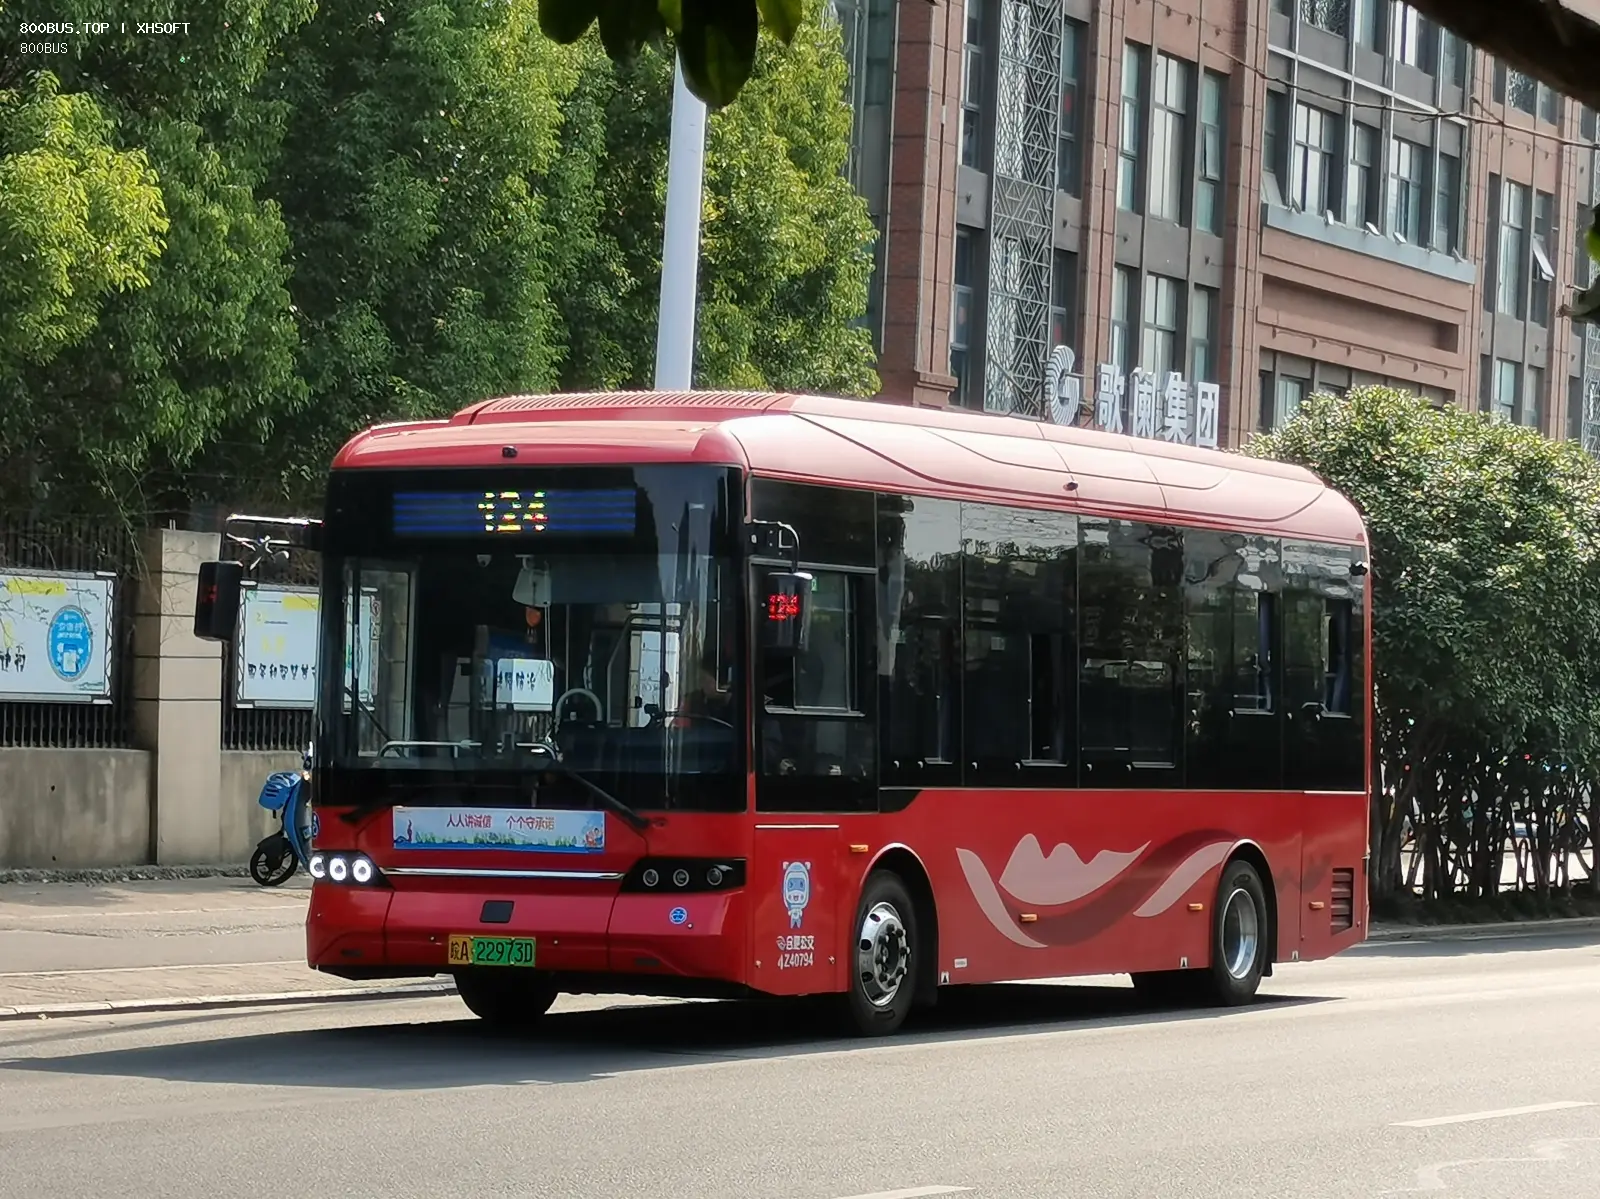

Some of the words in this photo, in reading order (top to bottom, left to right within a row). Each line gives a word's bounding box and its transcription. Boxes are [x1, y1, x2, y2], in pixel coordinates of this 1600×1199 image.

[478, 491, 548, 532] 124
[446, 813, 493, 829] 人人讲诚信
[506, 815, 555, 831] 个个守承诺
